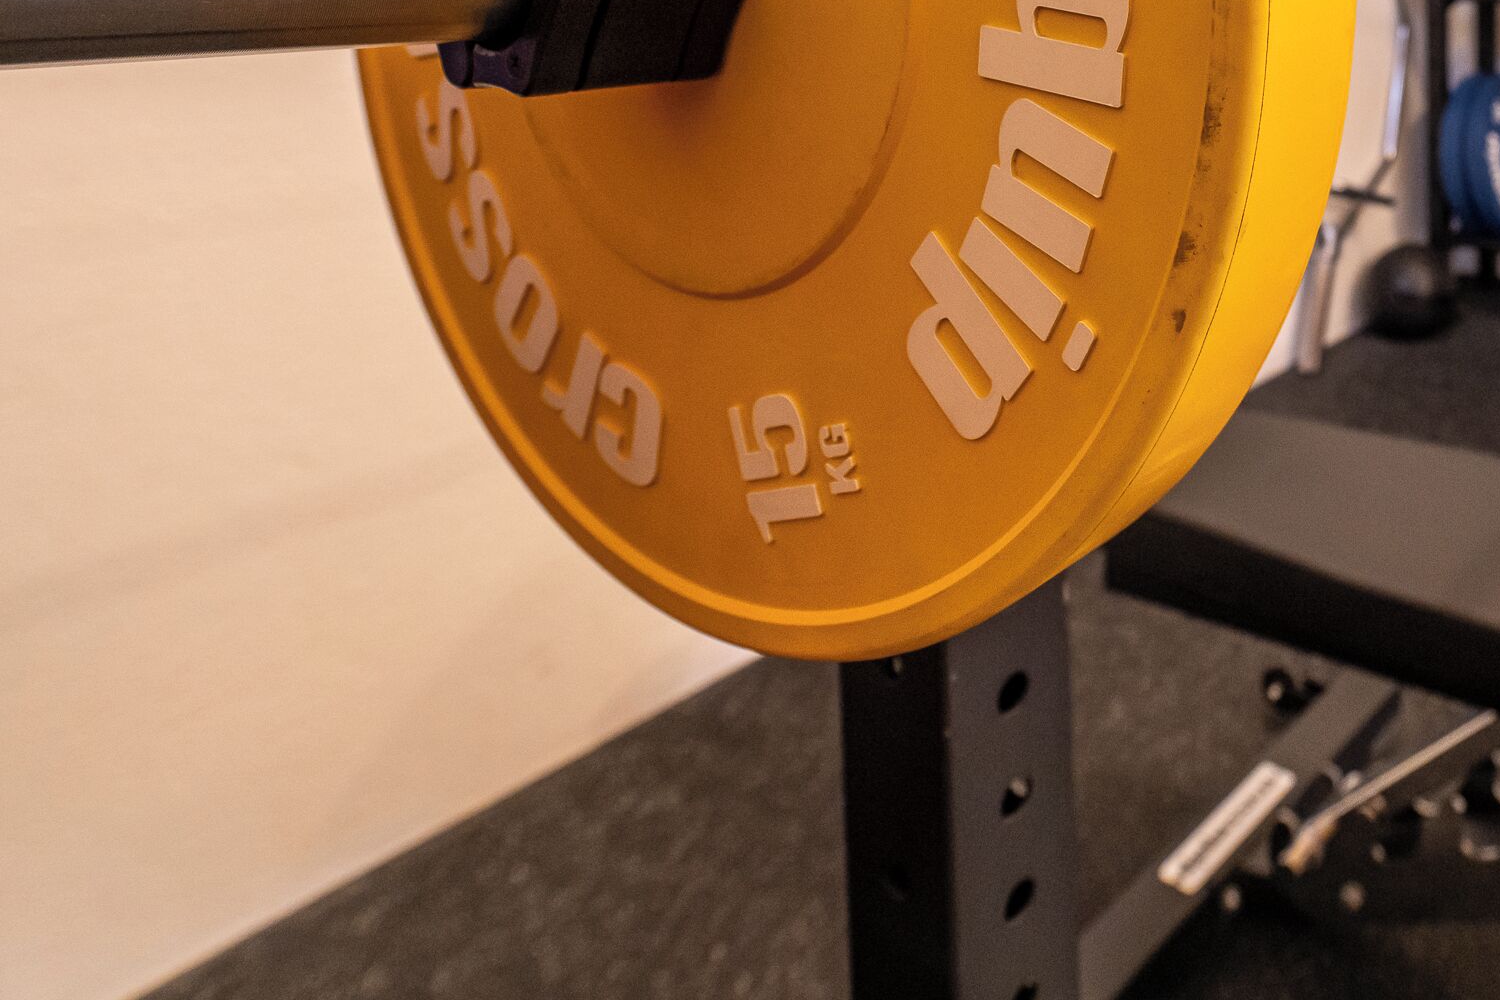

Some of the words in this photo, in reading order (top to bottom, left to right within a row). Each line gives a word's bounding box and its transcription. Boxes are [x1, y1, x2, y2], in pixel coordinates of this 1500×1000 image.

[415, 79, 664, 488] cross
[728, 393, 823, 544] 15
[818, 421, 861, 495] KG
